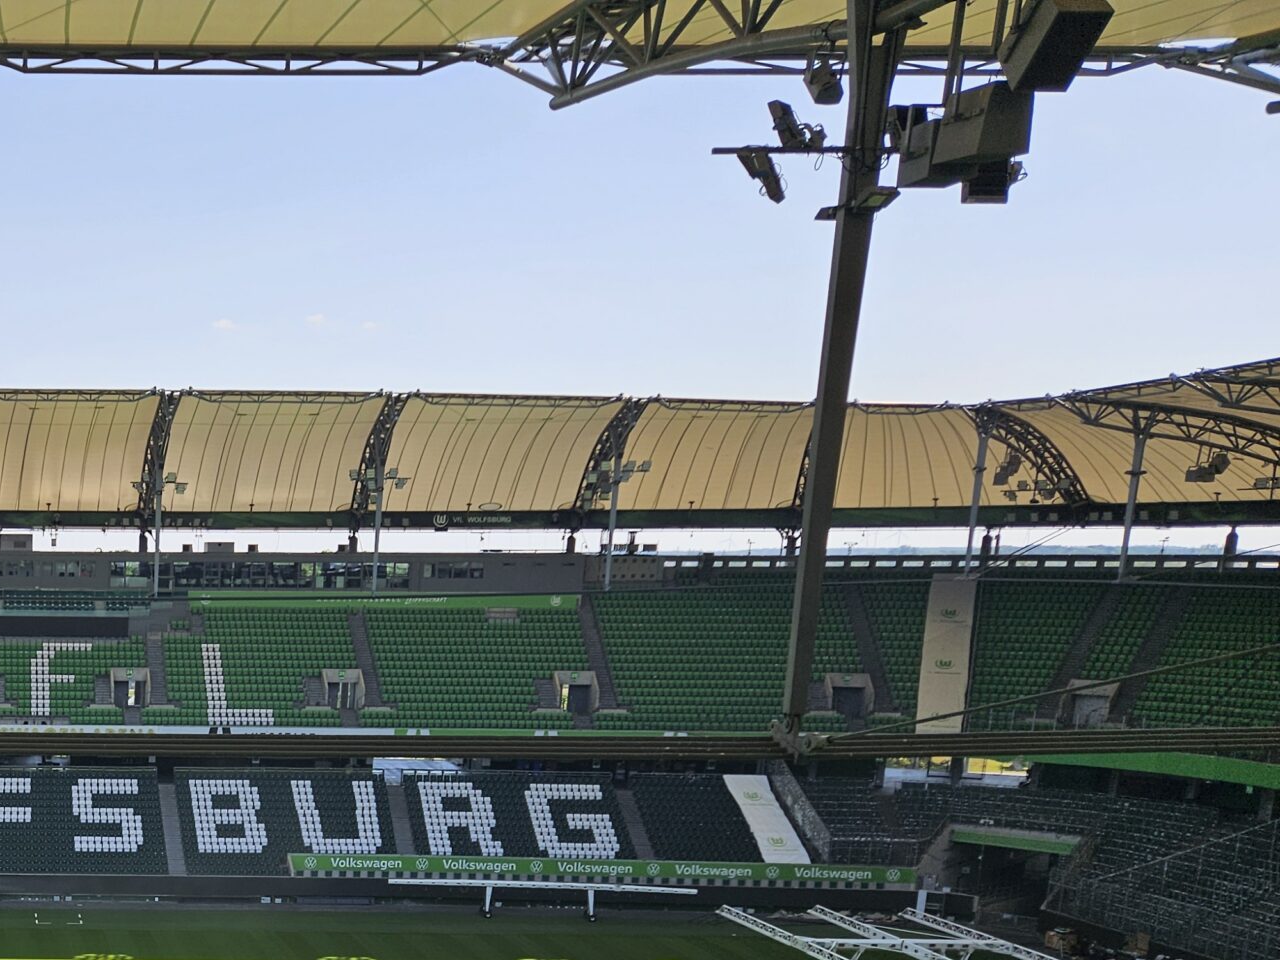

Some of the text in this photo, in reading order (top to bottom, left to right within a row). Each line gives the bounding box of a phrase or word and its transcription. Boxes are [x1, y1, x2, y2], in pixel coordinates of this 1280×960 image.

[330, 857, 403, 870] Volkswagen
[442, 858, 517, 873] Volkswagen
[557, 861, 633, 875] Volkswagen
[675, 863, 752, 878] Volkswagen
[794, 866, 872, 881] Volkswagen
